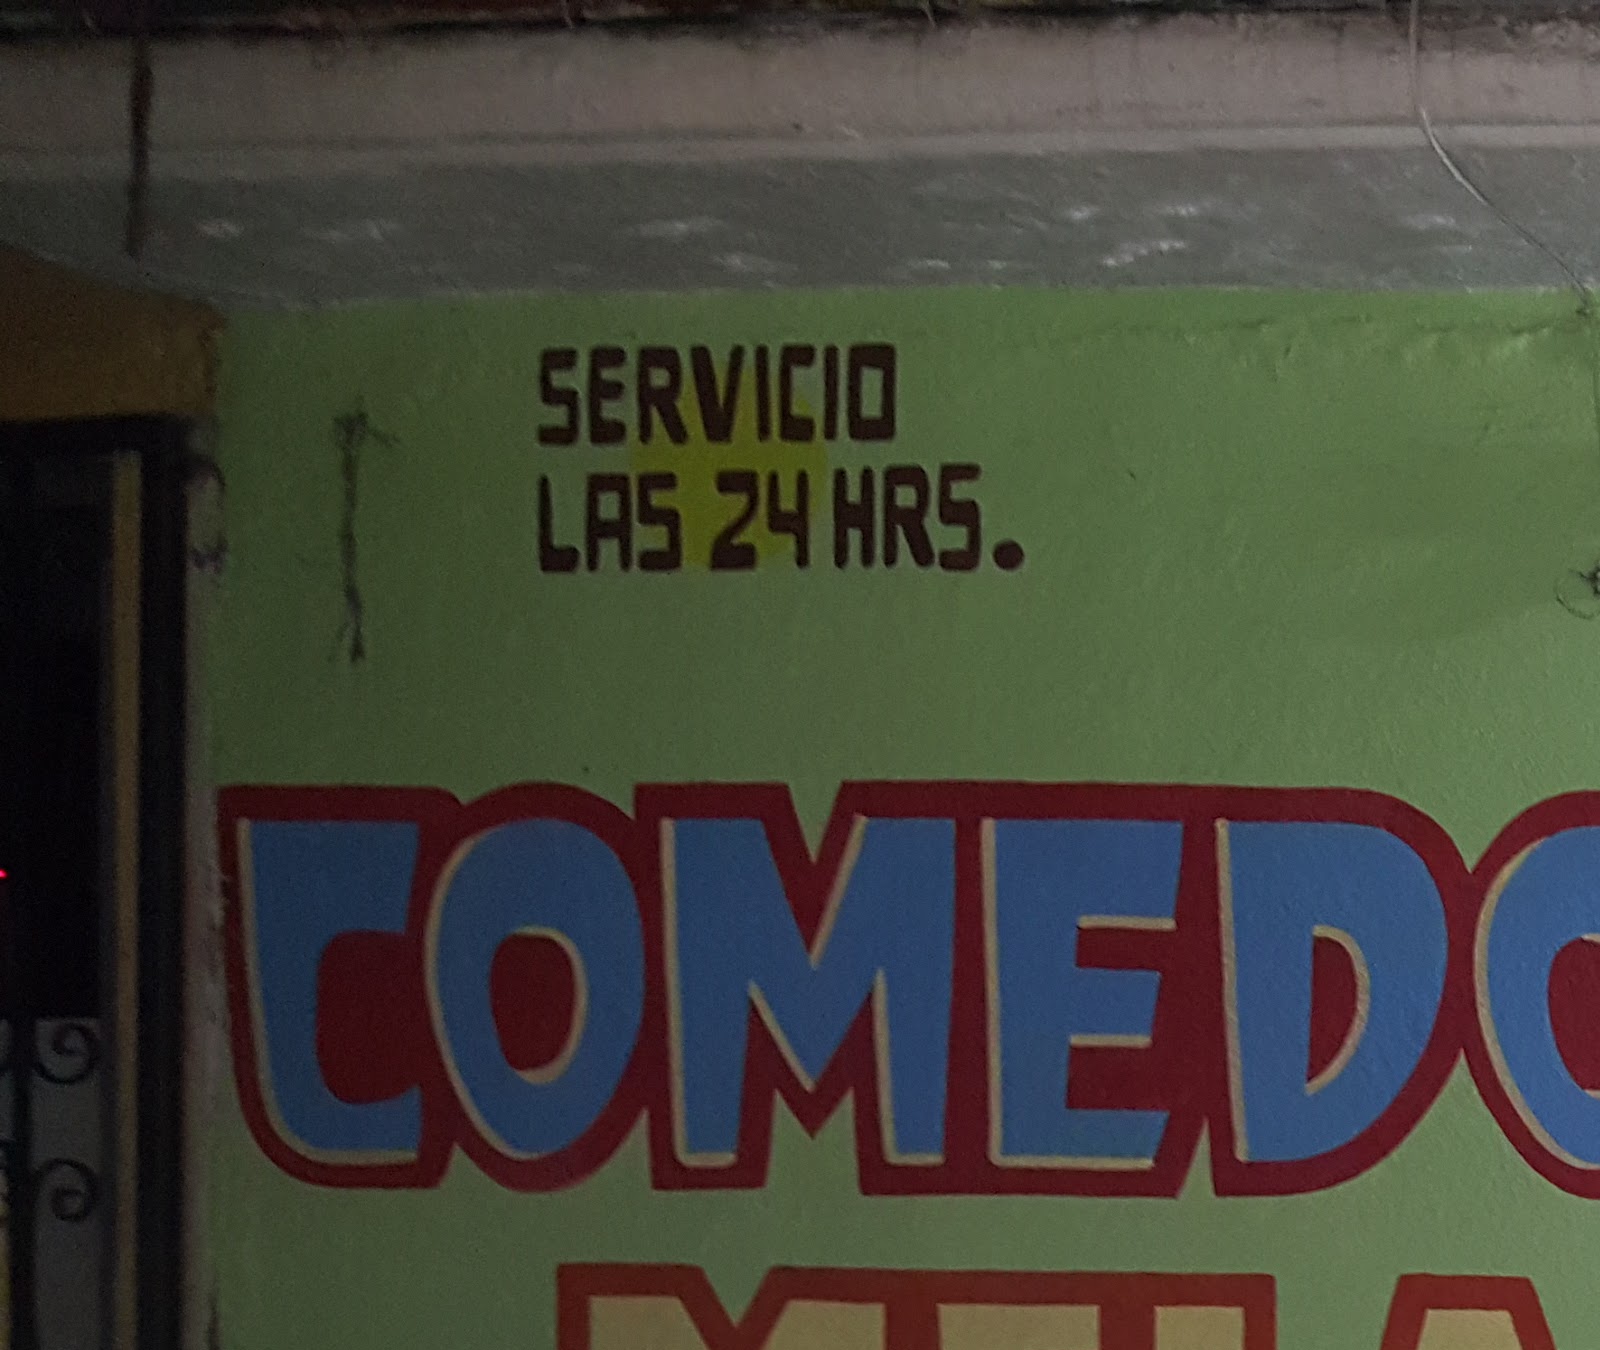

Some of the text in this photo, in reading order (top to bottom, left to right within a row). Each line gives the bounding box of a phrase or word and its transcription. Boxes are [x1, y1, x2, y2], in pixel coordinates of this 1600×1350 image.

[536, 342, 898, 448] SERVICIO
[536, 463, 1025, 574] LAS 24 HRS.
